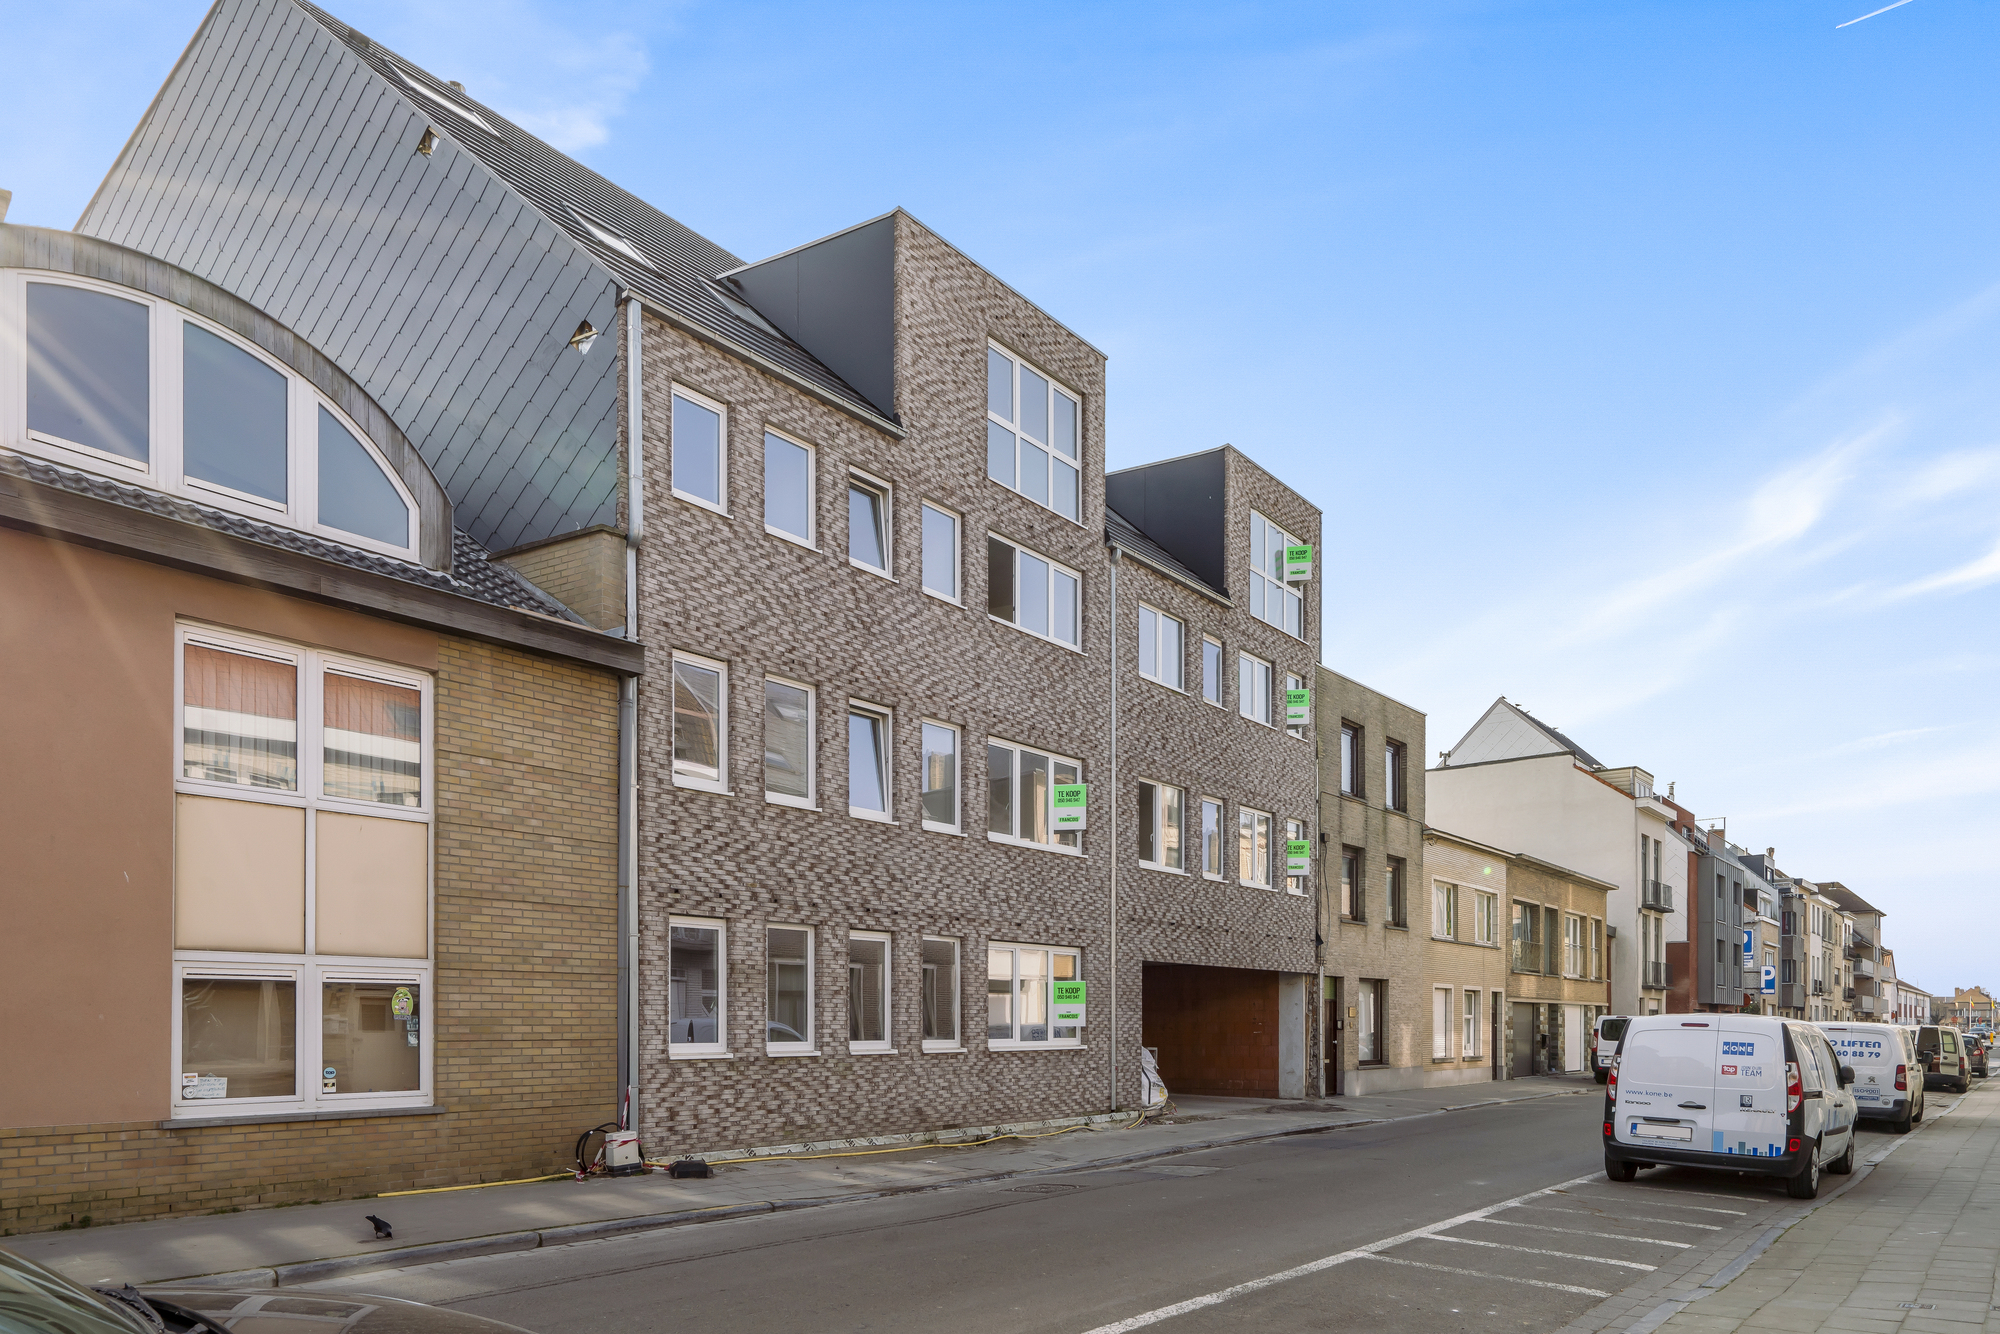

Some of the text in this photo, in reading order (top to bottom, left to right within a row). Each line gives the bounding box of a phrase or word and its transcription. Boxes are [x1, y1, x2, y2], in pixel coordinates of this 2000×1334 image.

[1761, 966, 1775, 987] P
[1841, 1040, 1881, 1048] LIFTEN
[1625, 1090, 1673, 1098] www.kone.be
